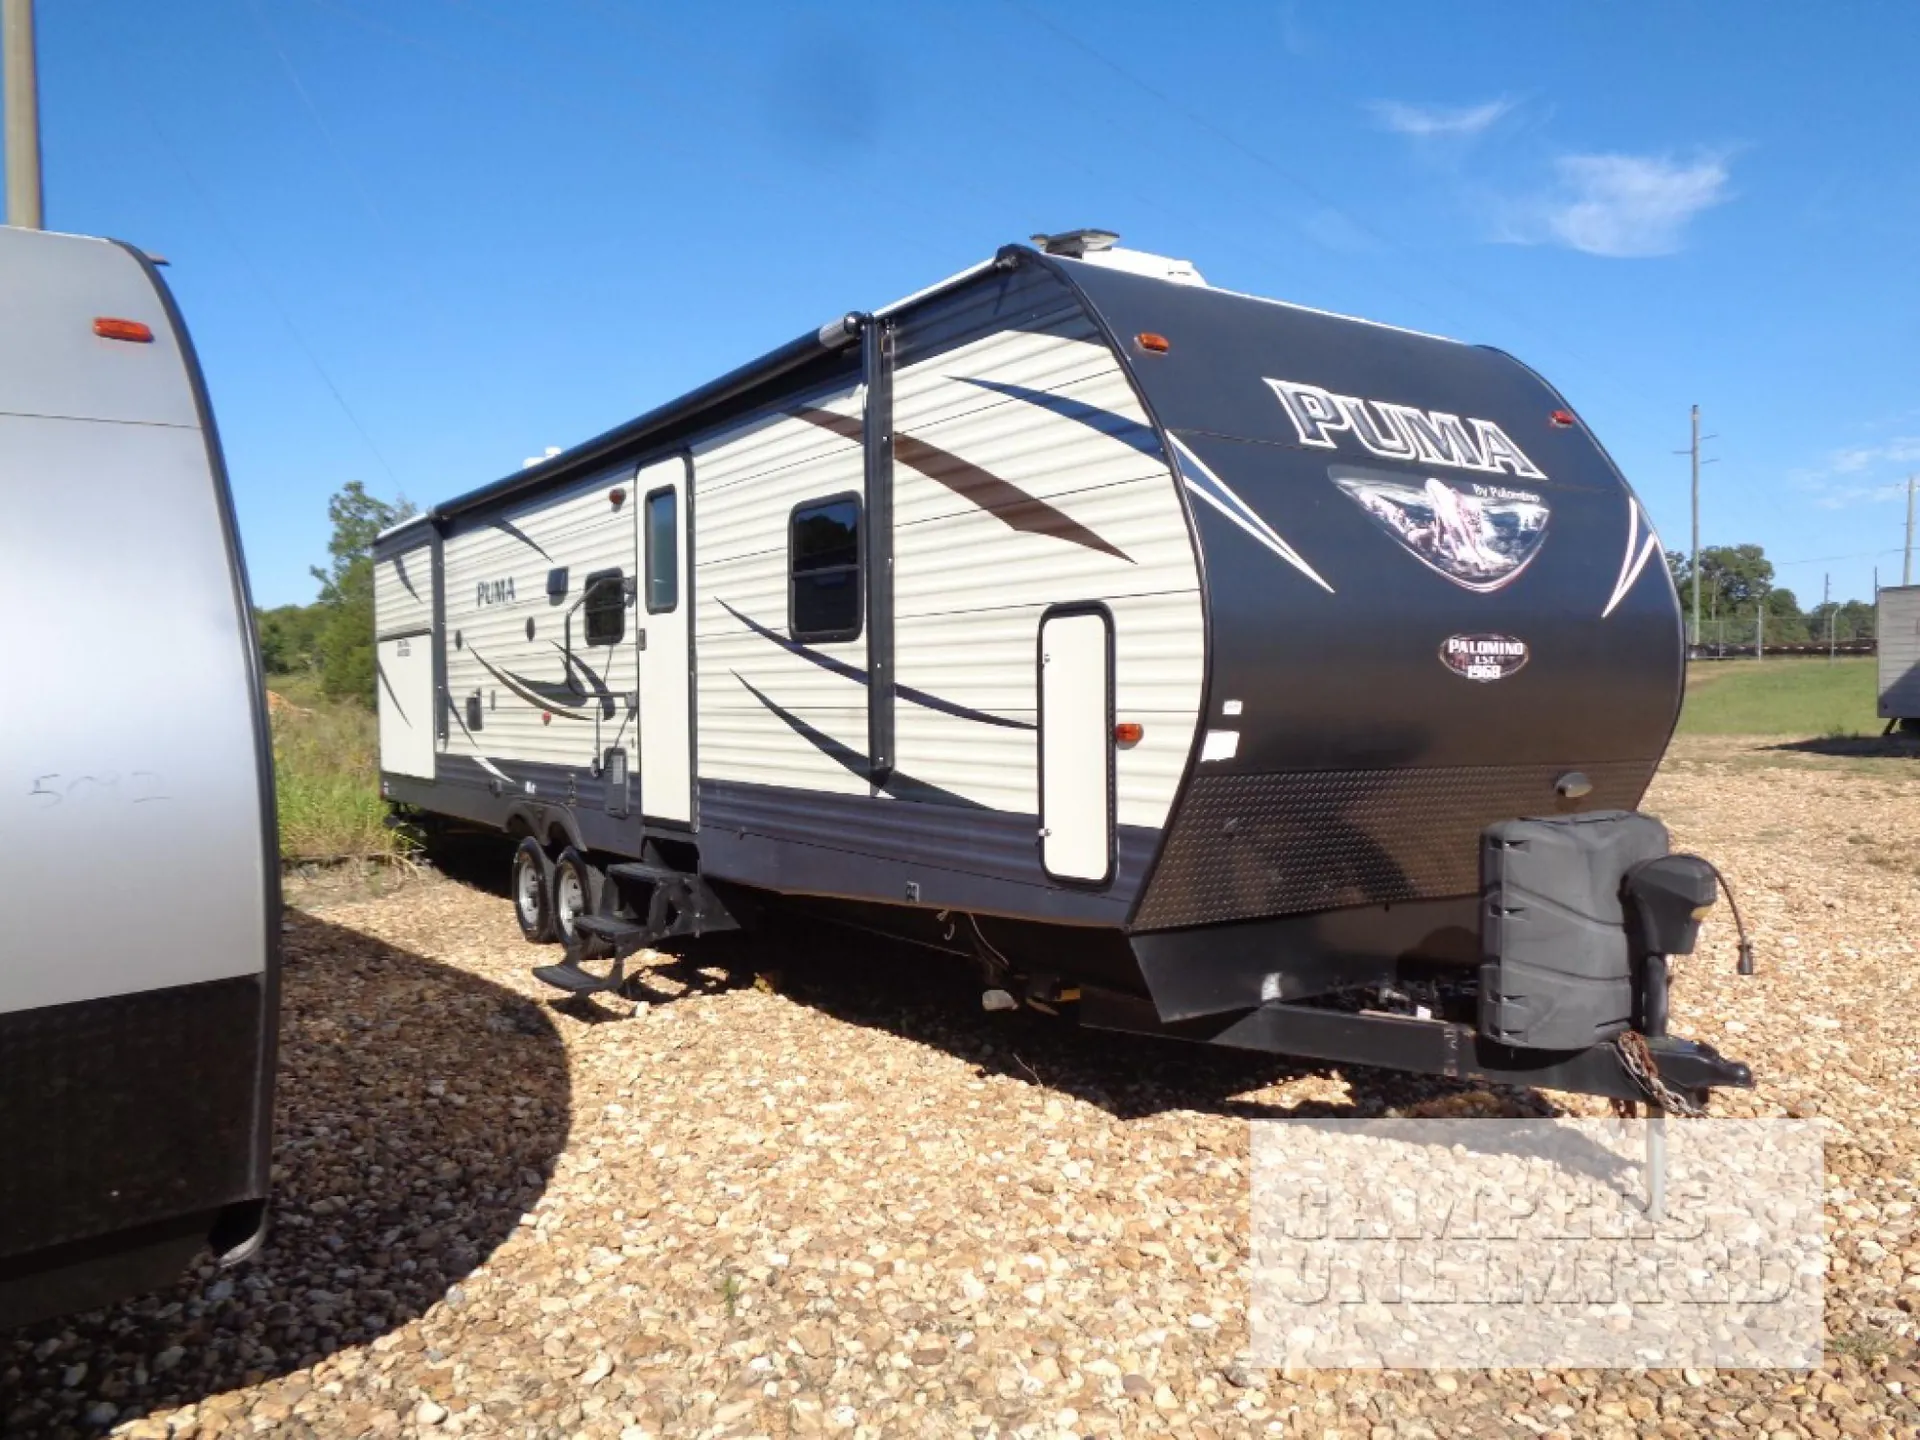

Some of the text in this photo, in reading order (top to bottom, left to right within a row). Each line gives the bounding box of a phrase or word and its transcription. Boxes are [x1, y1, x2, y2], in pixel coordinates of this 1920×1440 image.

[1262, 377, 1549, 480] PUMA
[476, 576, 516, 607] PUMA
[1448, 640, 1524, 655] PALOMINO
